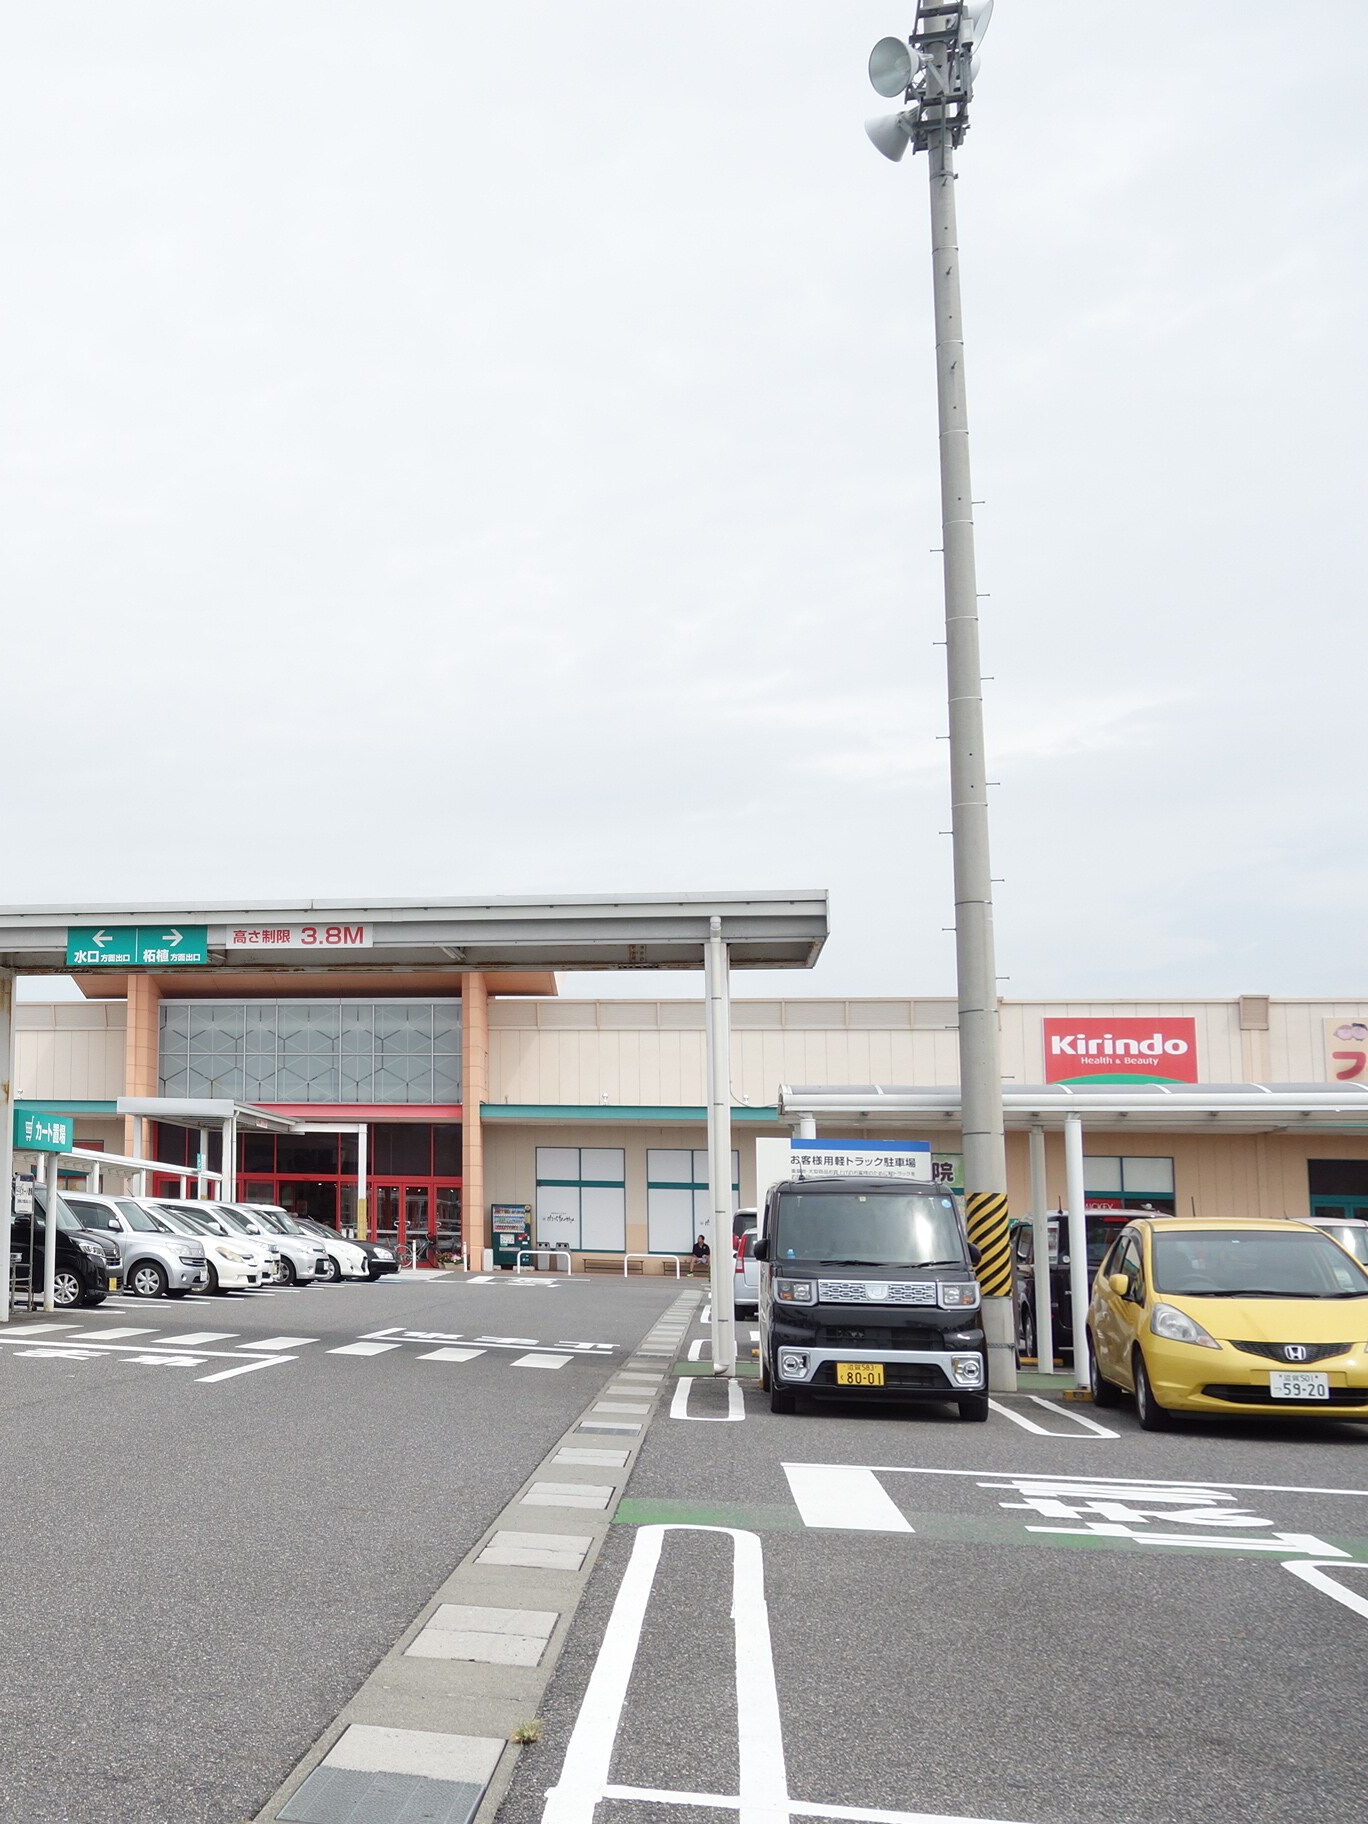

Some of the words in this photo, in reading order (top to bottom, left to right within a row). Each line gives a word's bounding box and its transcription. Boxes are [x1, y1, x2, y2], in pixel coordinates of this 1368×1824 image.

[233, 930, 291, 945] 高さ制限
[300, 926, 364, 945] 3.8M
[1051, 1033, 1189, 1055] Kirindo
[1080, 1056, 1113, 1065] Health
[1124, 1056, 1159, 1066] Beauty
[35, 1121, 66, 1145] カート置場
[790, 1155, 917, 1168] お客様用軽トラック駐車場
[932, 1162, 954, 1182] 院
[846, 1372, 881, 1385] 80-01
[1283, 1382, 1326, 1397] 59-20
